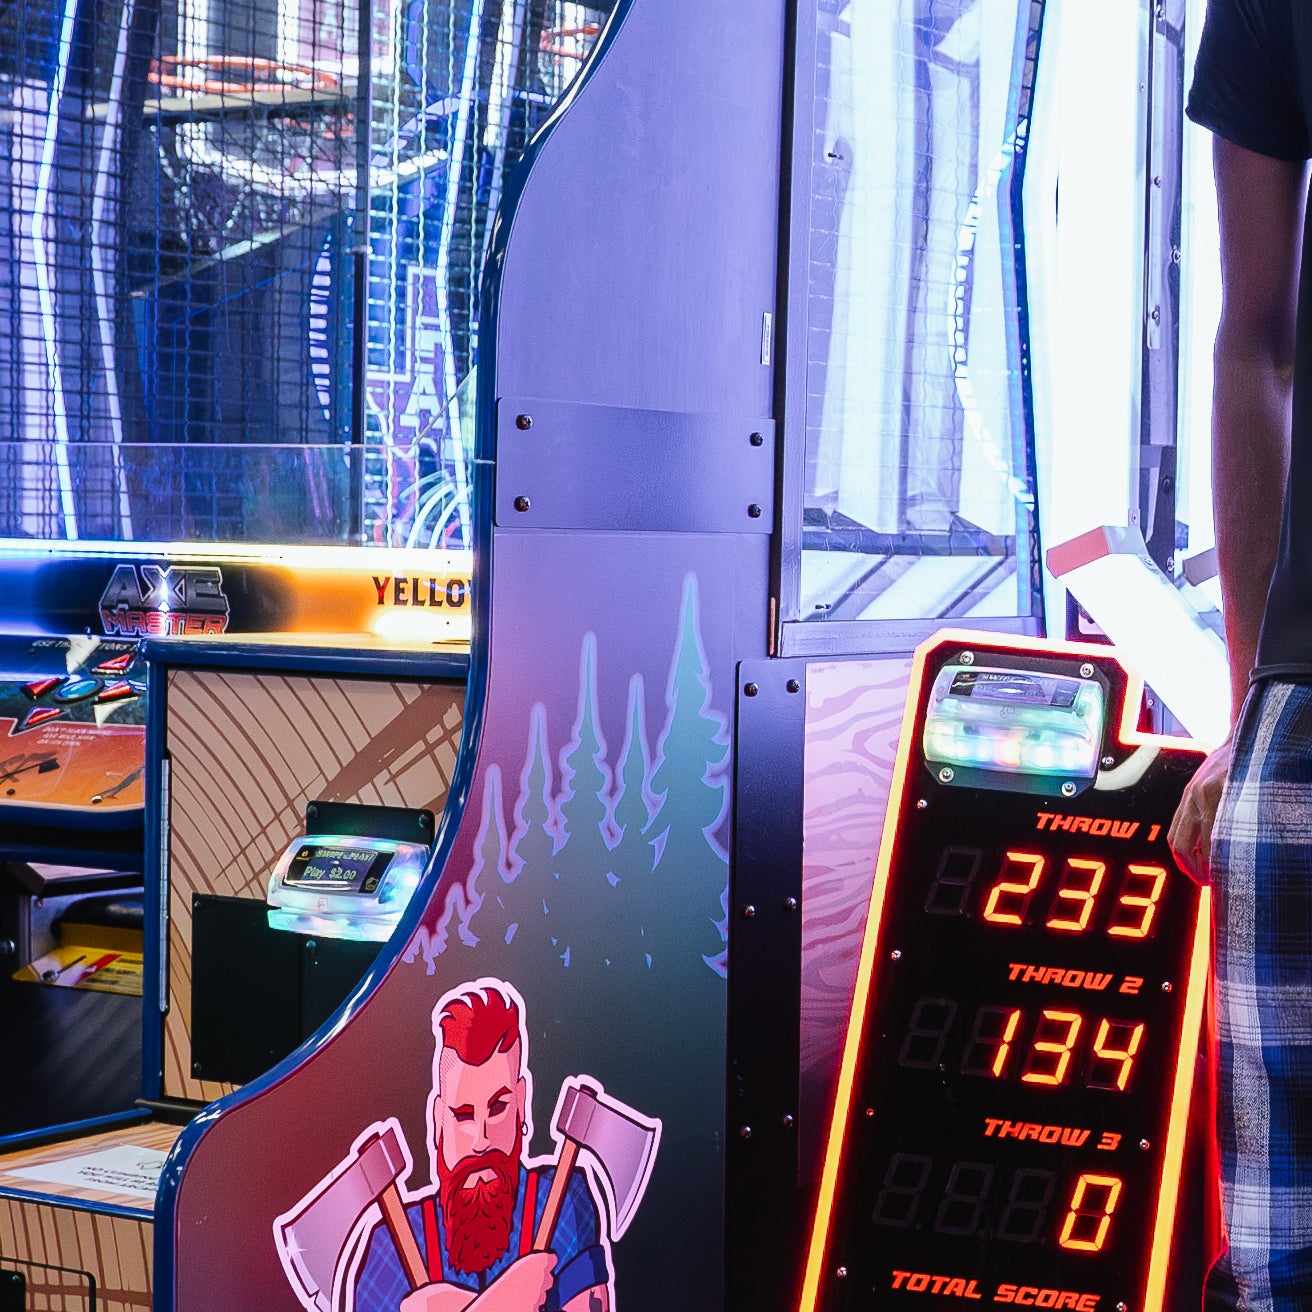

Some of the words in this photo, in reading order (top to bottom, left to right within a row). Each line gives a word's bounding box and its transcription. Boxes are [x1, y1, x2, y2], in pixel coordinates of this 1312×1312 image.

[101, 566, 228, 608] AXE
[372, 576, 473, 608] YELLO
[102, 610, 228, 635] MASTER
[1036, 812, 1139, 839] THROW
[1147, 824, 1161, 842] 1
[303, 866, 325, 880] Play
[983, 851, 1167, 938] 233
[1008, 963, 1113, 991] THROW
[1119, 976, 1144, 994] 2
[992, 1008, 1144, 1091] 134
[984, 1118, 1091, 1147] THROW
[1097, 1132, 1122, 1151] 3
[1059, 1173, 1123, 1252] 0
[891, 1270, 982, 1299] TOTAL
[993, 1285, 1101, 1312] SCORE
